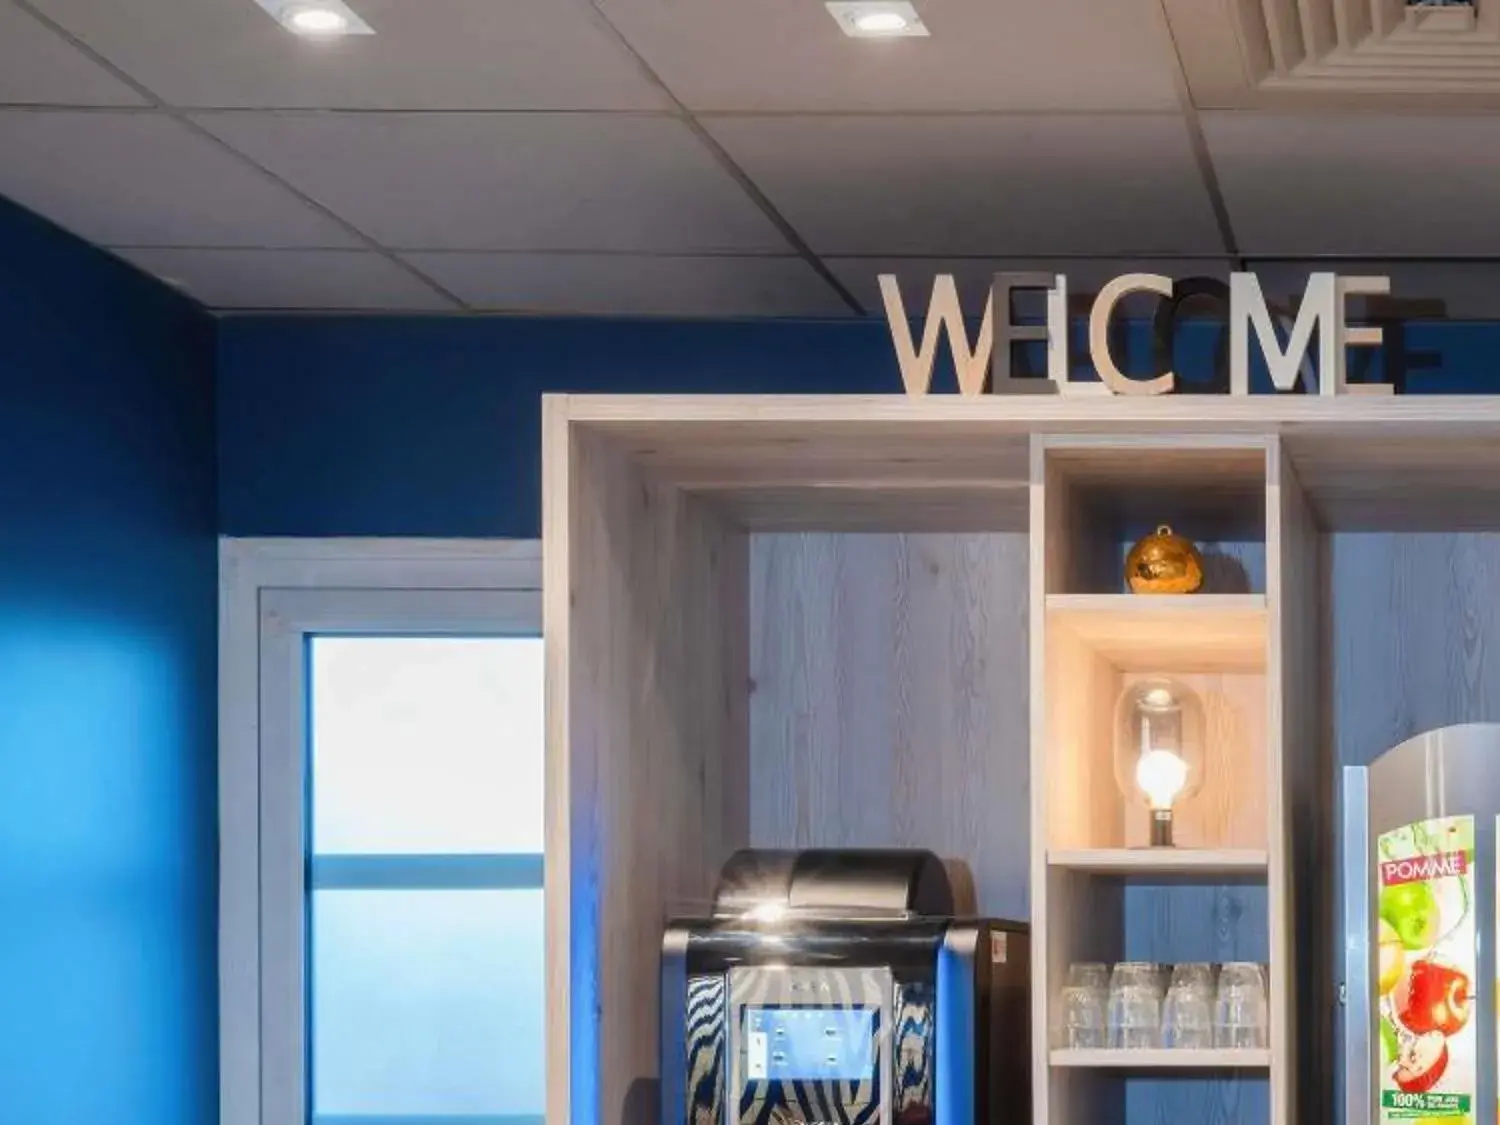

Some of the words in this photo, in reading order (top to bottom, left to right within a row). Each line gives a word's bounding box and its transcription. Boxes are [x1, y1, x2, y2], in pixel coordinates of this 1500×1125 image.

[878, 271, 1395, 397] WELCOME
[1385, 855, 1462, 881] POMME
[1391, 1092, 1425, 1108] 100%
